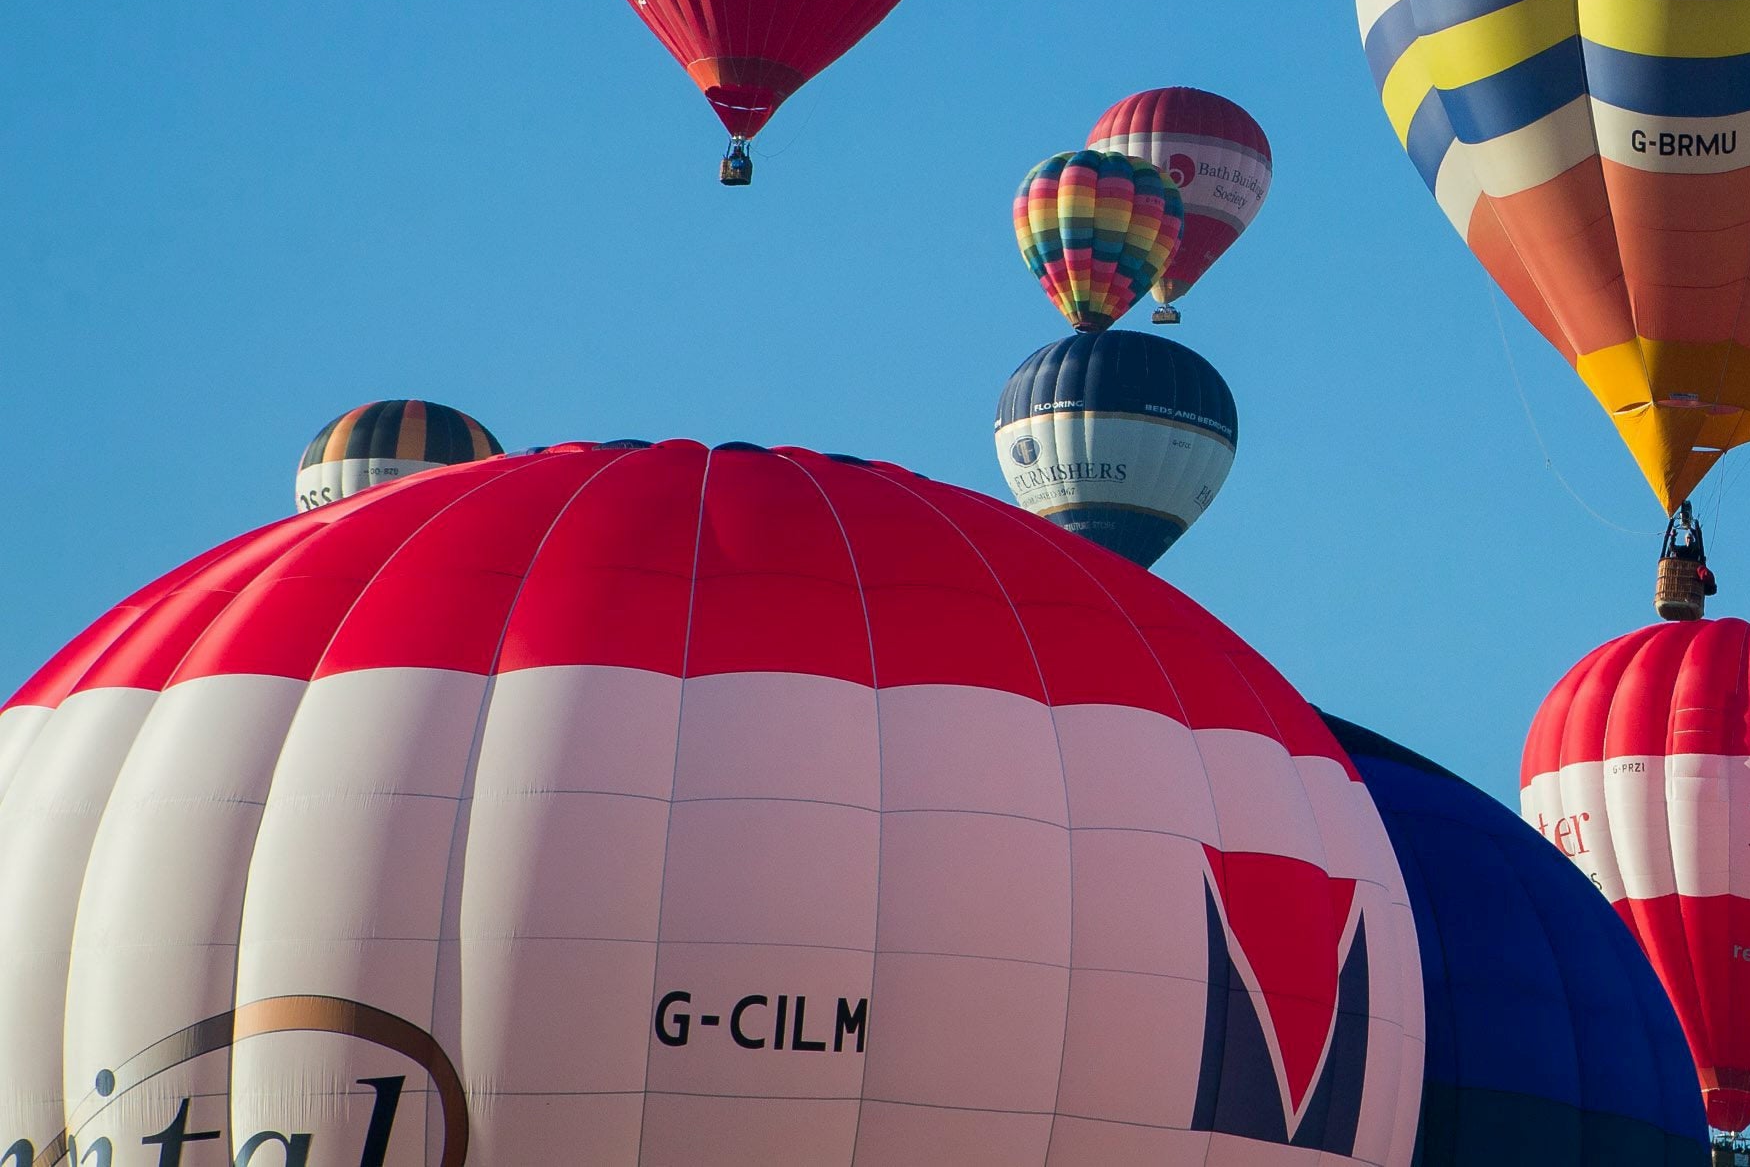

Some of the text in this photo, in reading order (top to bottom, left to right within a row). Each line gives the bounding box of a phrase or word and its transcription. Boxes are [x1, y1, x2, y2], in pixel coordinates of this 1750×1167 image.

[1631, 130, 1736, 156] G-BRMU
[1198, 162, 1230, 181] Bath
[1213, 184, 1248, 209] Society
[1034, 400, 1084, 412] FLOORING
[1145, 404, 1173, 415] BEDS
[1174, 410, 1196, 420] AND
[1015, 463, 1127, 492] FURNISHERS
[655, 991, 868, 1052] G-CILM
